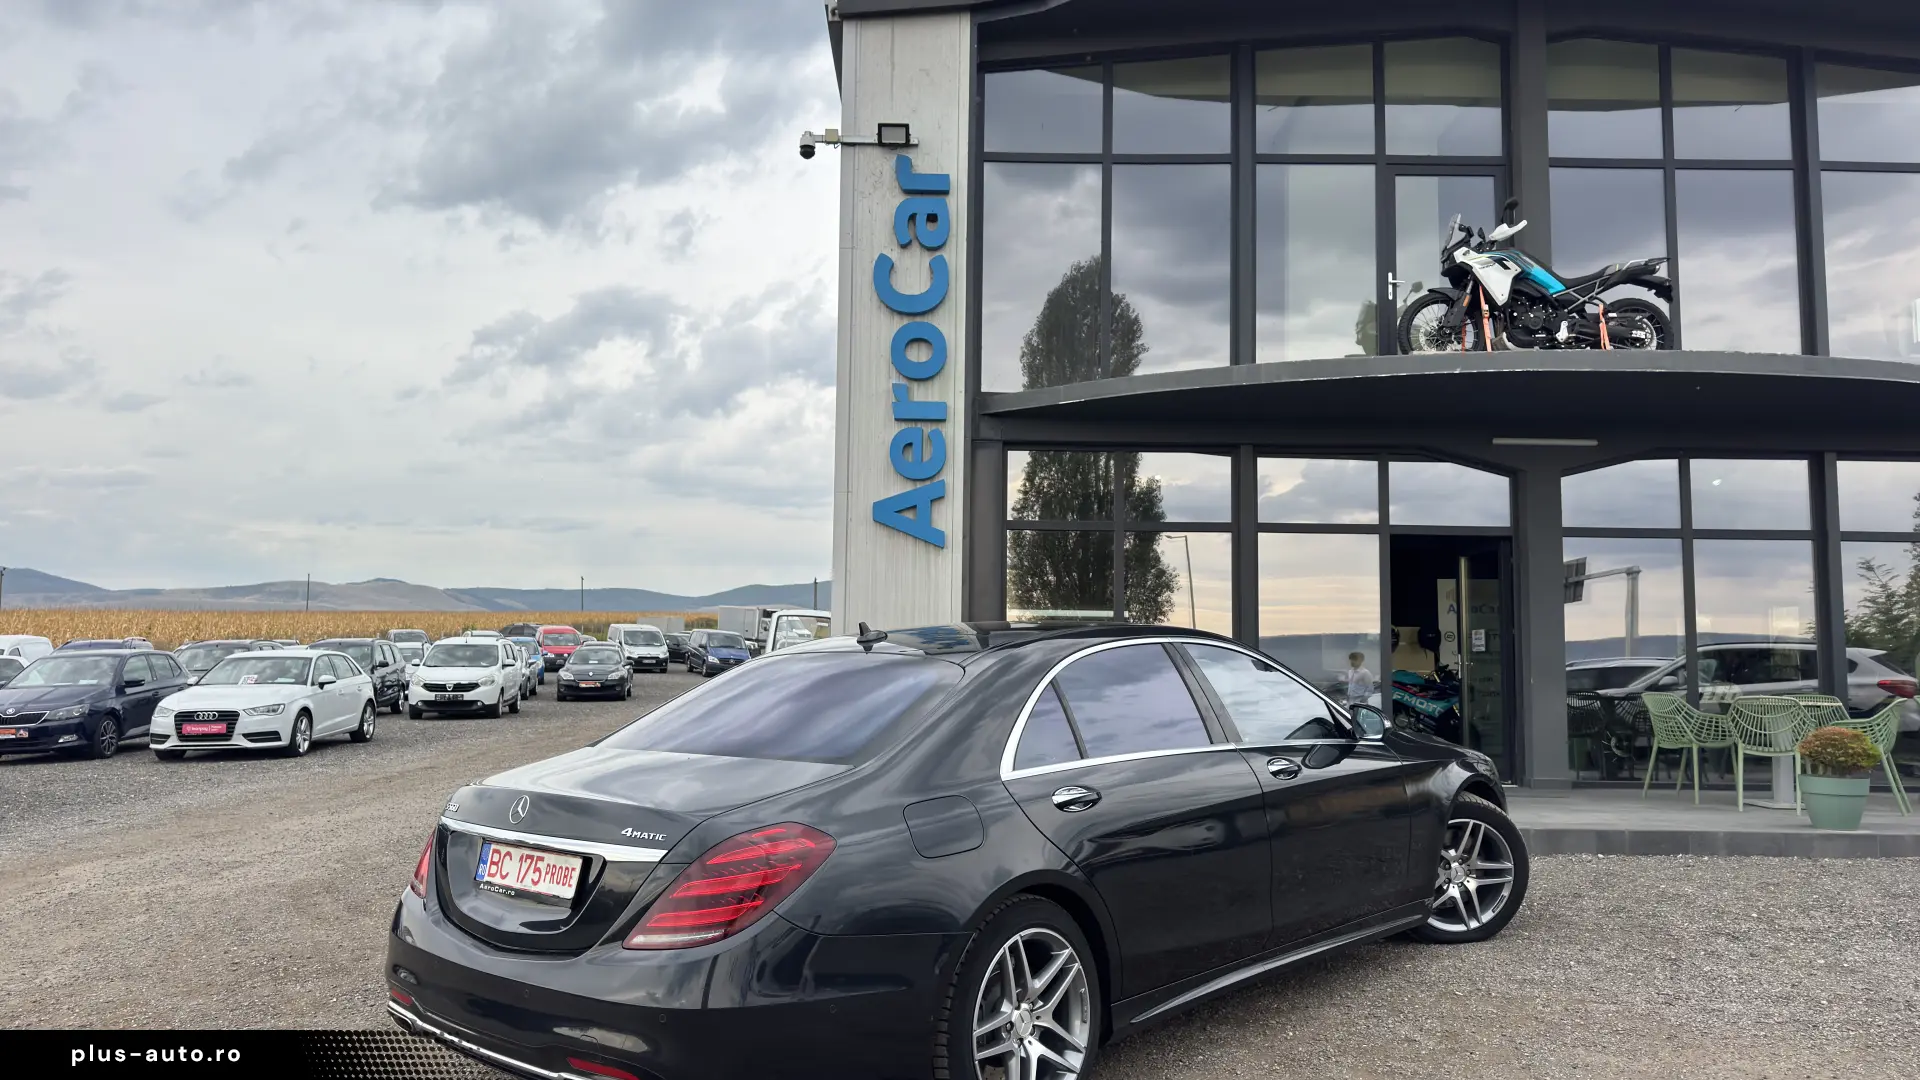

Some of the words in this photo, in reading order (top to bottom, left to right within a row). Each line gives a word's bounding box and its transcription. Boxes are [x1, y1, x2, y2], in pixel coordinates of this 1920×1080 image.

[873, 154, 950, 548] AeroCar
[621, 827, 667, 841] 4MATIC
[487, 848, 512, 880] BC
[516, 852, 545, 886] 175
[543, 863, 577, 888] PROBE
[480, 883, 515, 896] AeroCar.ro
